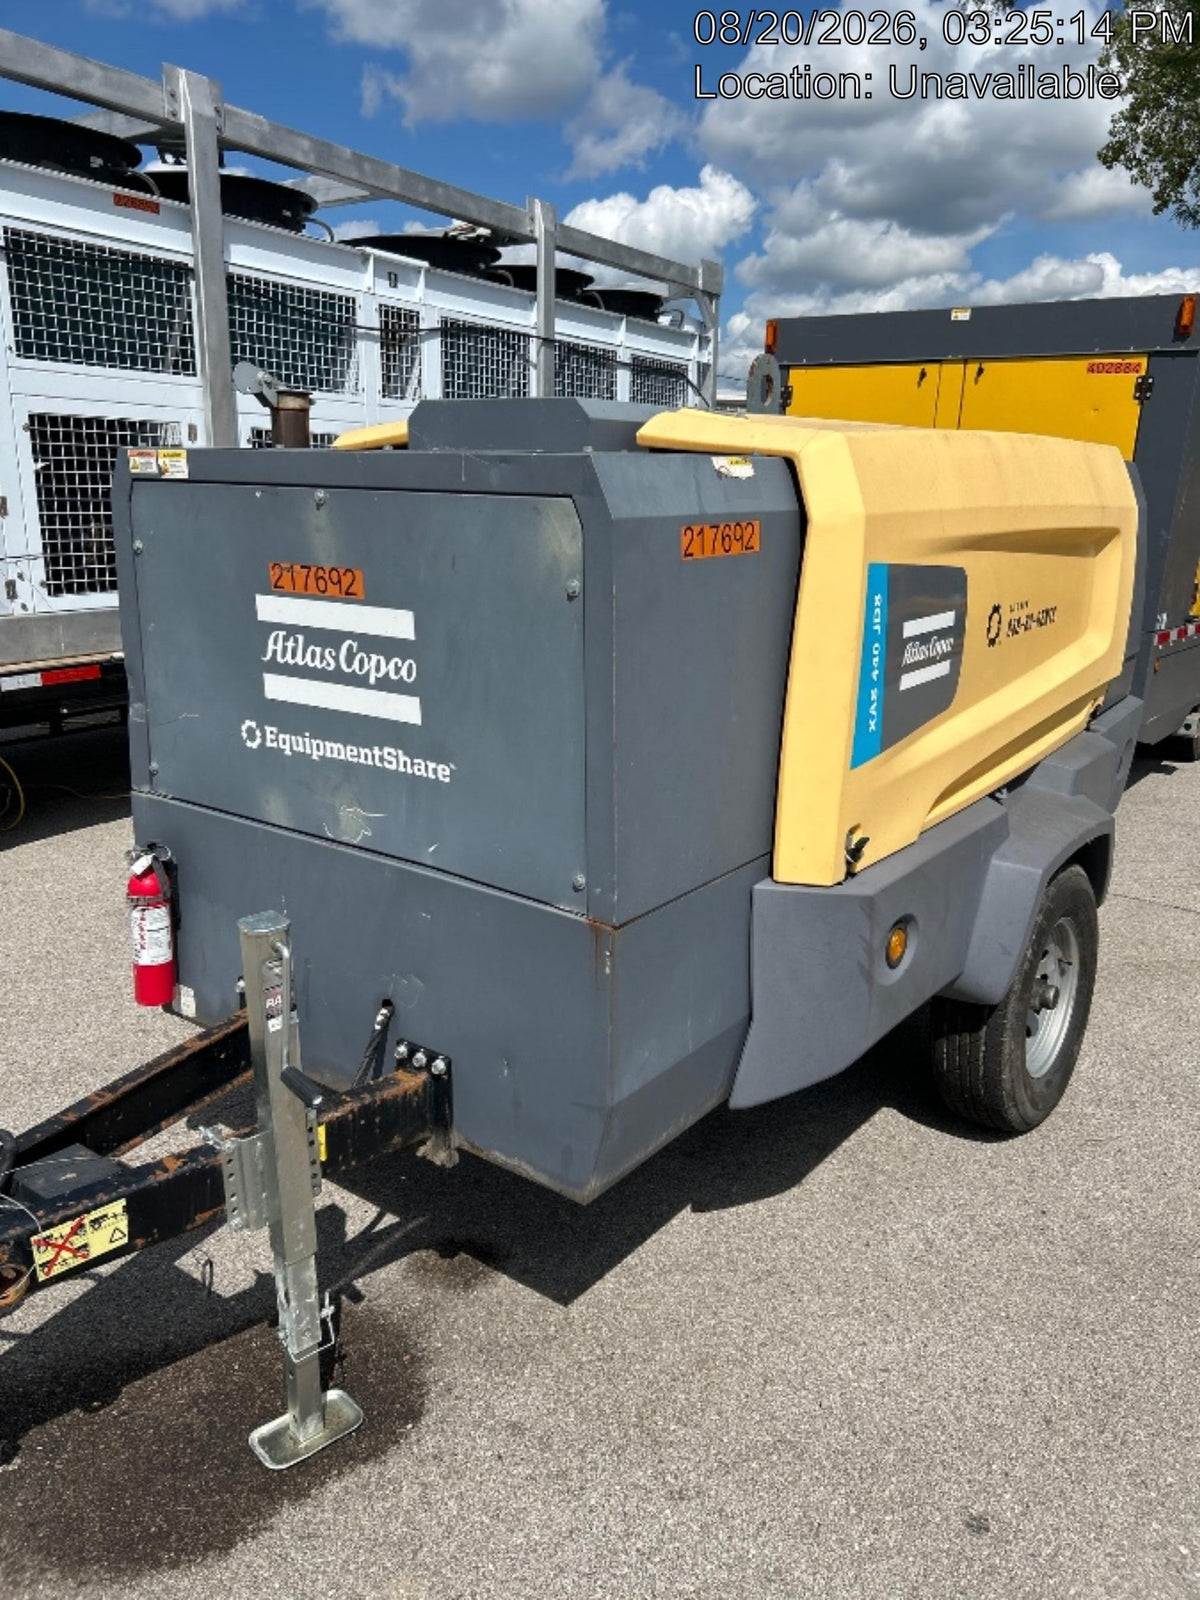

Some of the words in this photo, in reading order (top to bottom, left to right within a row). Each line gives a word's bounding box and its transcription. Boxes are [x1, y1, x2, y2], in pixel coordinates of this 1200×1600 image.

[684, 522, 754, 557] 217692
[271, 563, 358, 596] 217692
[873, 594, 882, 634] JD8
[262, 630, 336, 671] Atlas
[338, 640, 417, 684] Copco
[872, 643, 882, 681] 440
[264, 726, 453, 783] EquipmentShare
